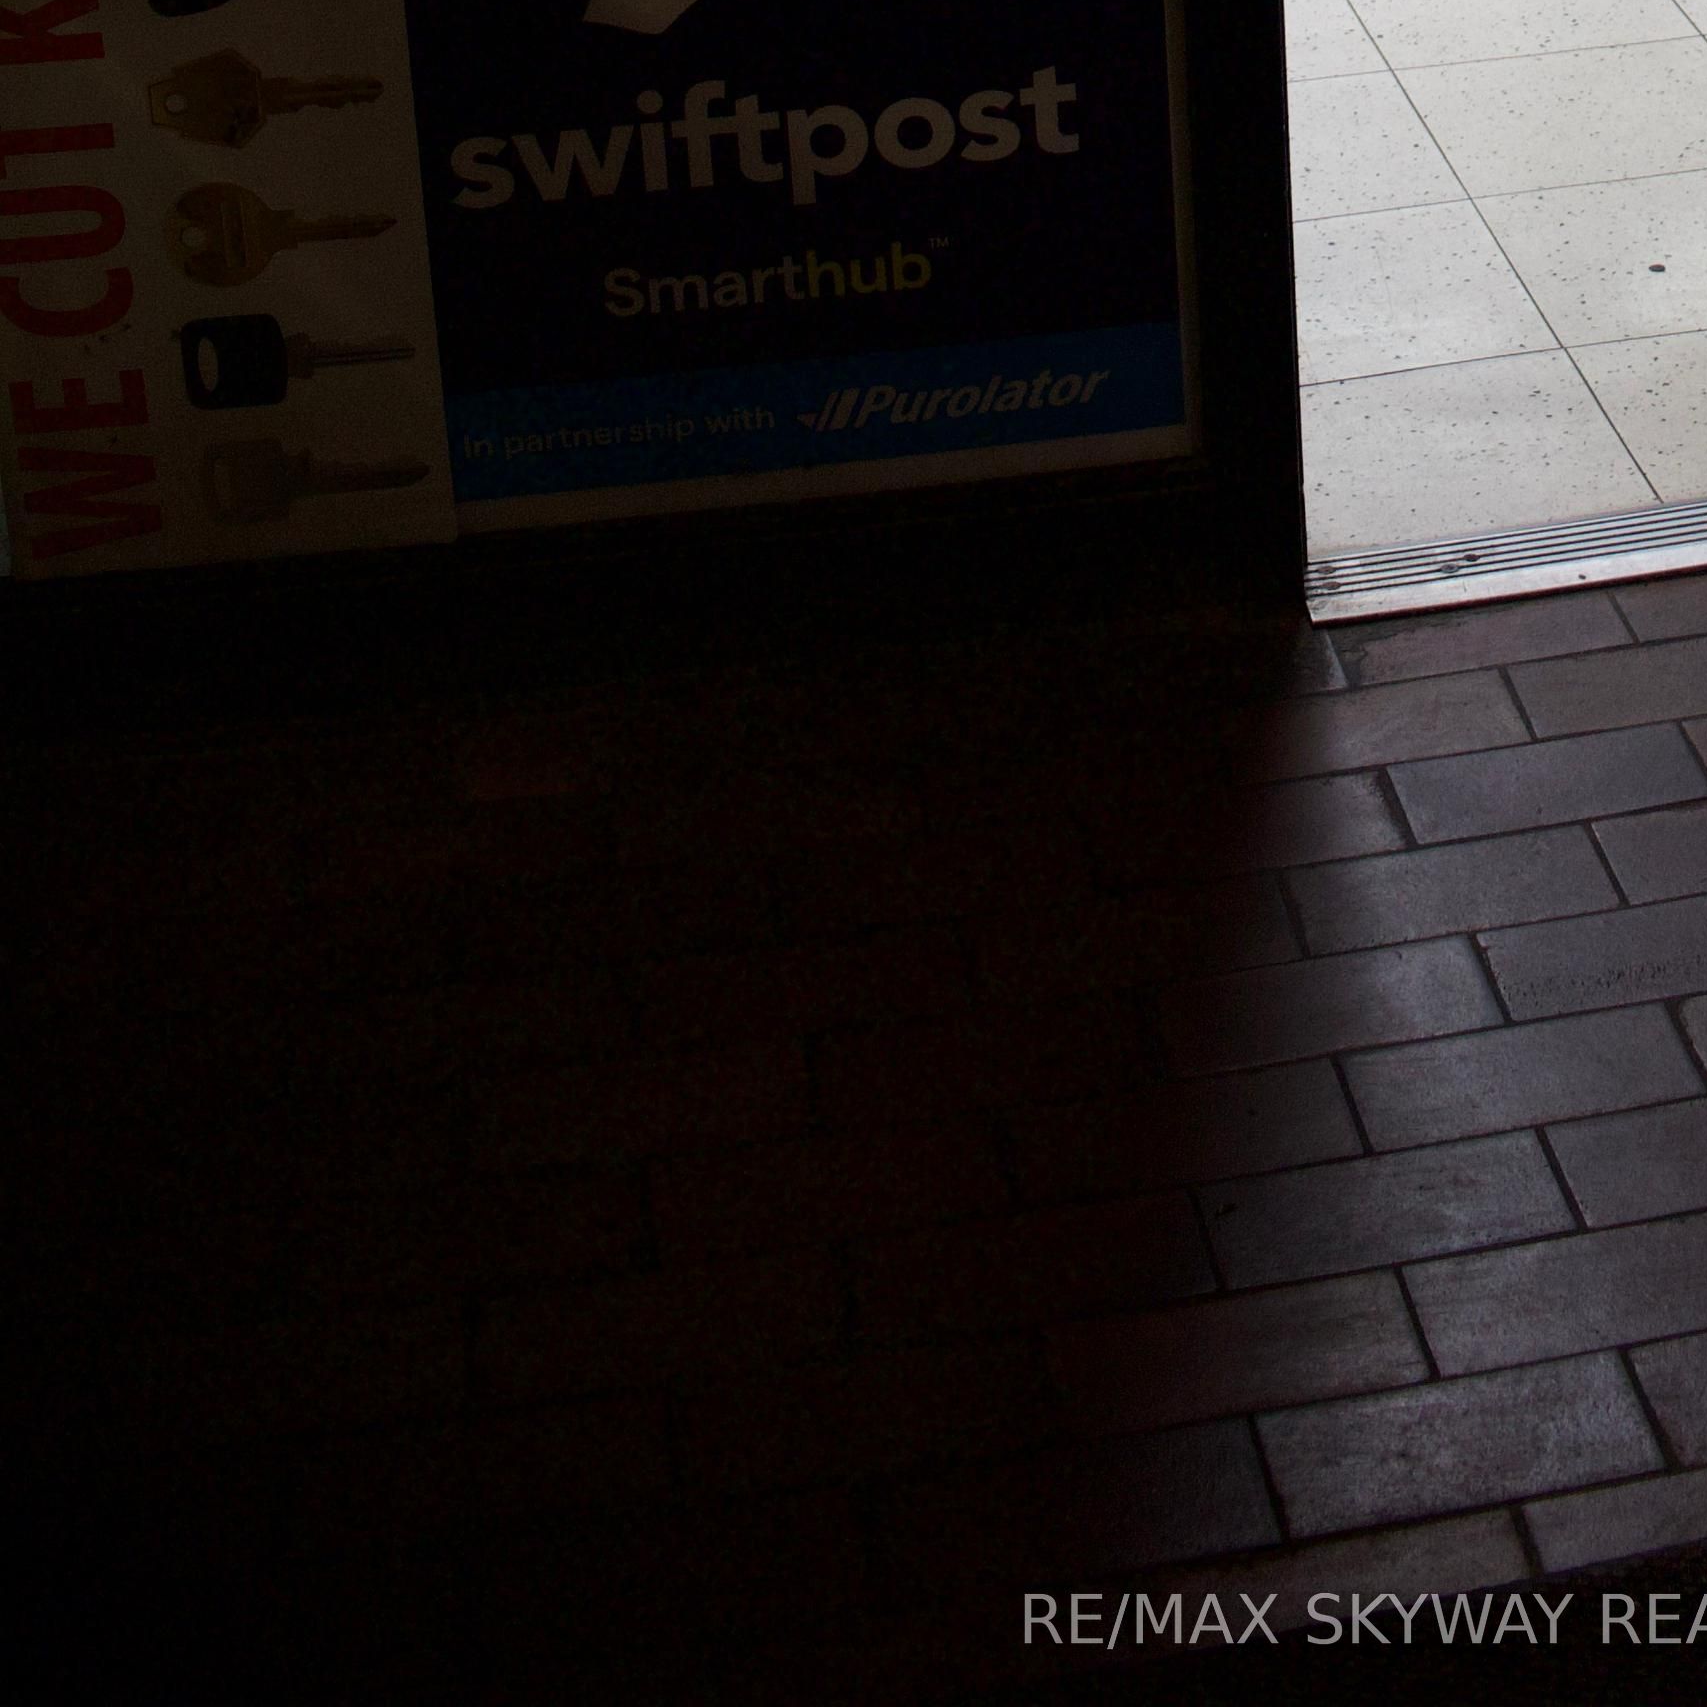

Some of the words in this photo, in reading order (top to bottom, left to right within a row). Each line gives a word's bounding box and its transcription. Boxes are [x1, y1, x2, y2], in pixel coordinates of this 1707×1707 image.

[449, 66, 1081, 210] swiftpost
[0, 122, 134, 338] CUT
[12, 369, 164, 561] WE
[463, 433, 497, 460] In
[503, 410, 697, 462] partnership
[703, 404, 776, 435] with
[853, 364, 1111, 431] Purolator
